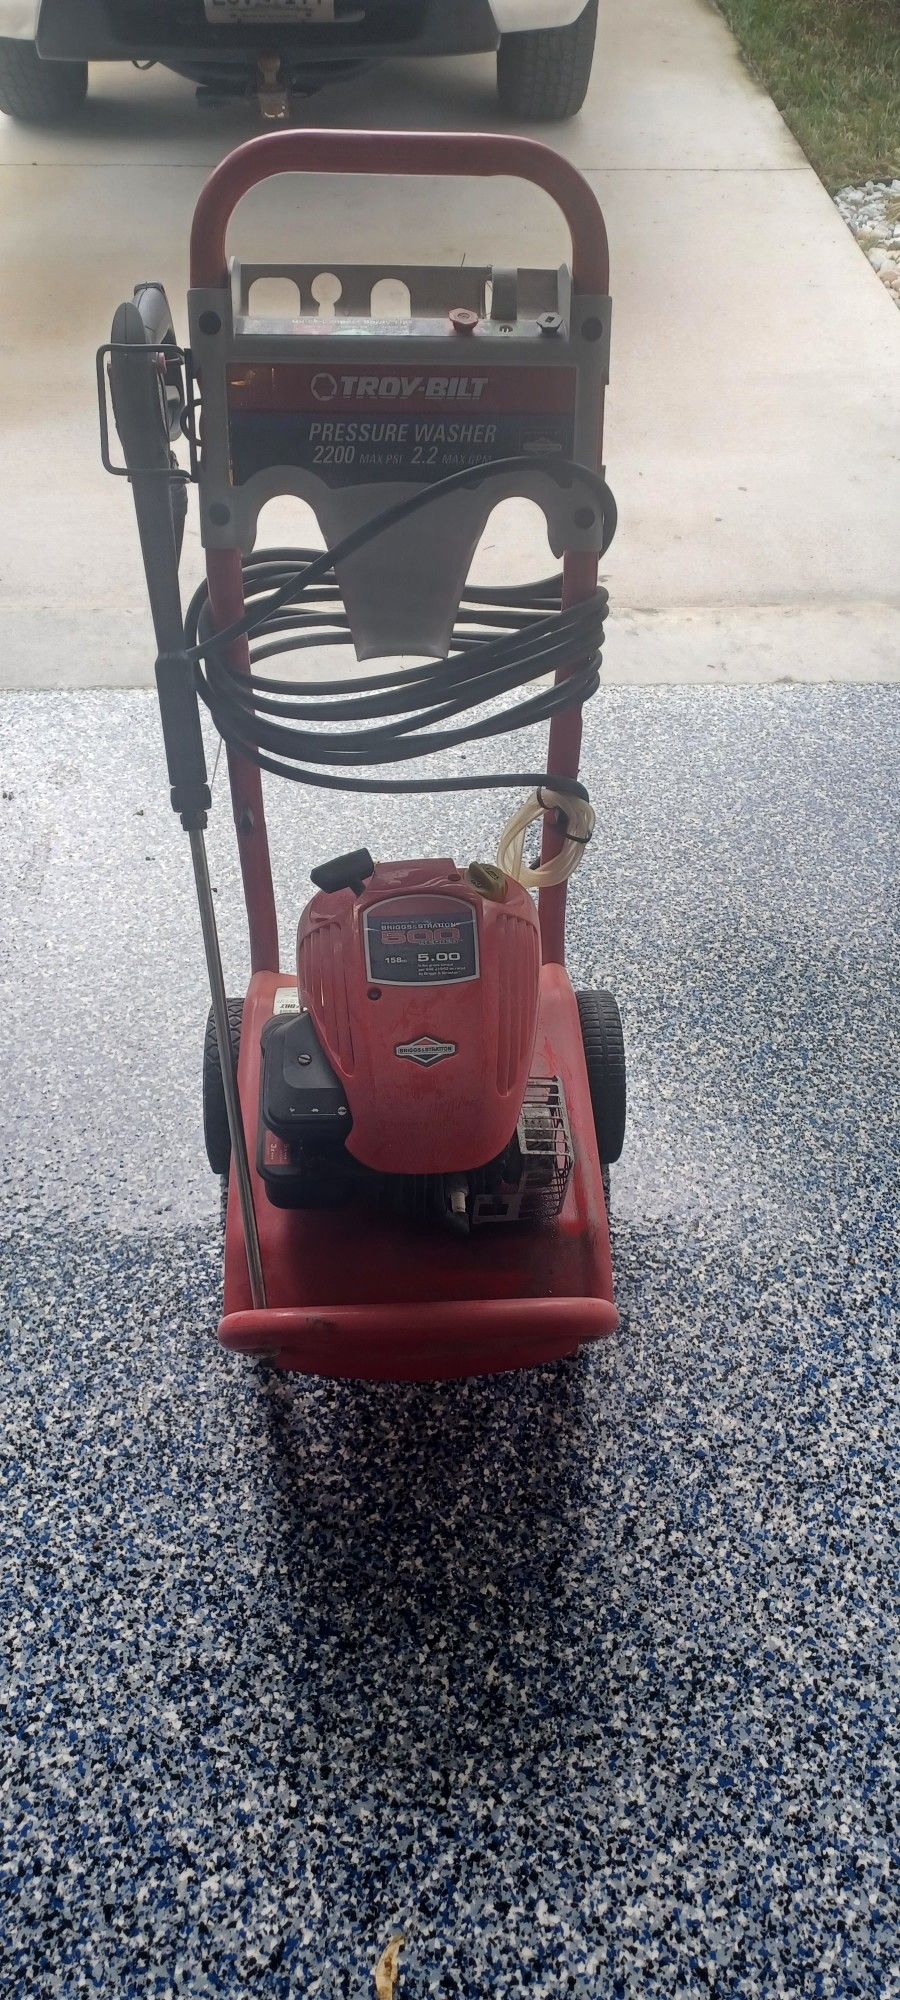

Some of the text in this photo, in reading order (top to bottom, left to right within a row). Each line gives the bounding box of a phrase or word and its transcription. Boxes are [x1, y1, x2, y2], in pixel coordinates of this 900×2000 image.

[340, 376, 488, 399] TROY-BILT
[308, 423, 497, 443] PRESSURE WASHER
[312, 445, 355, 464] 2200
[359, 453, 383, 464] MAX
[384, 453, 403, 464] PSI
[411, 446, 438, 464] 2.2
[442, 454, 466, 464] MAX
[381, 928, 460, 945] 500
[417, 952, 461, 962] 5.00
